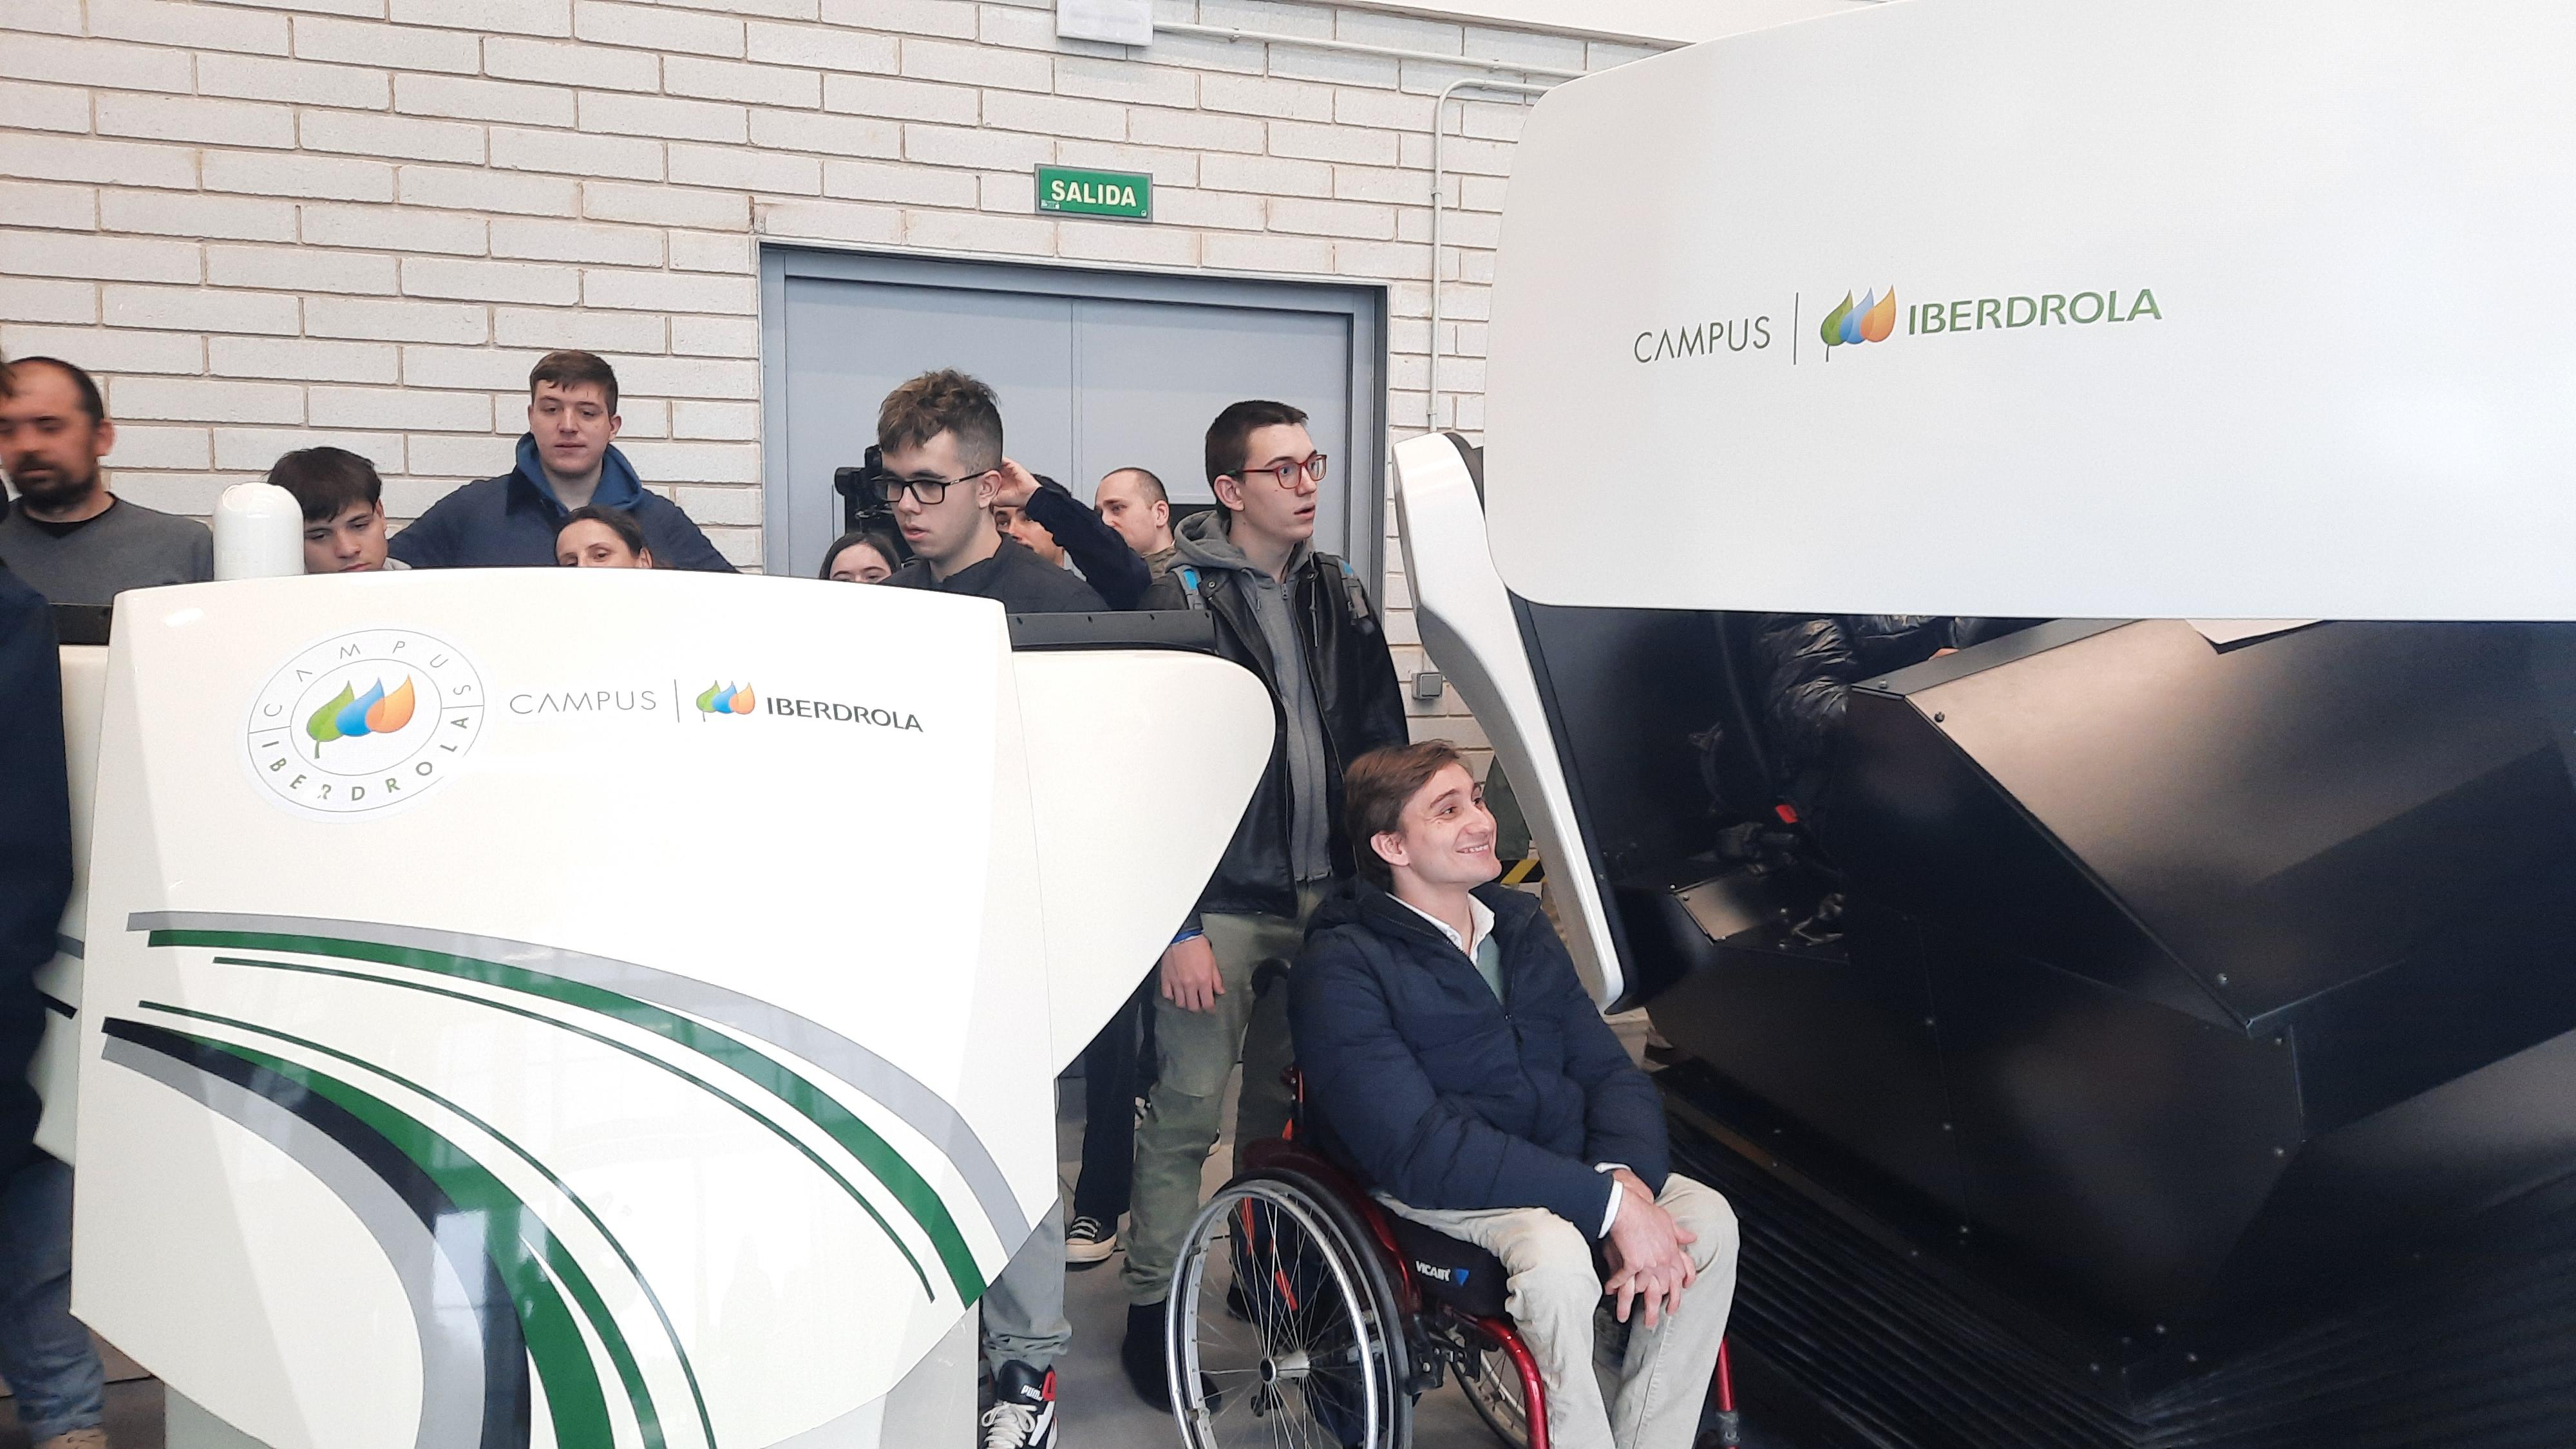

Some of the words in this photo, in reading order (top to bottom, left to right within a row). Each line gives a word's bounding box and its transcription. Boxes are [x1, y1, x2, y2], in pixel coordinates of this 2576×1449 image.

[1050, 180, 1137, 207] SALIDA
[1634, 316, 1772, 364] CAMPUS
[1908, 289, 2164, 337] IBERDROLA
[263, 640, 471, 717] CAMPUS
[509, 690, 657, 715] CAMPUS
[767, 697, 925, 734] IBERDROLA
[261, 717, 469, 802] IBERDROLA
